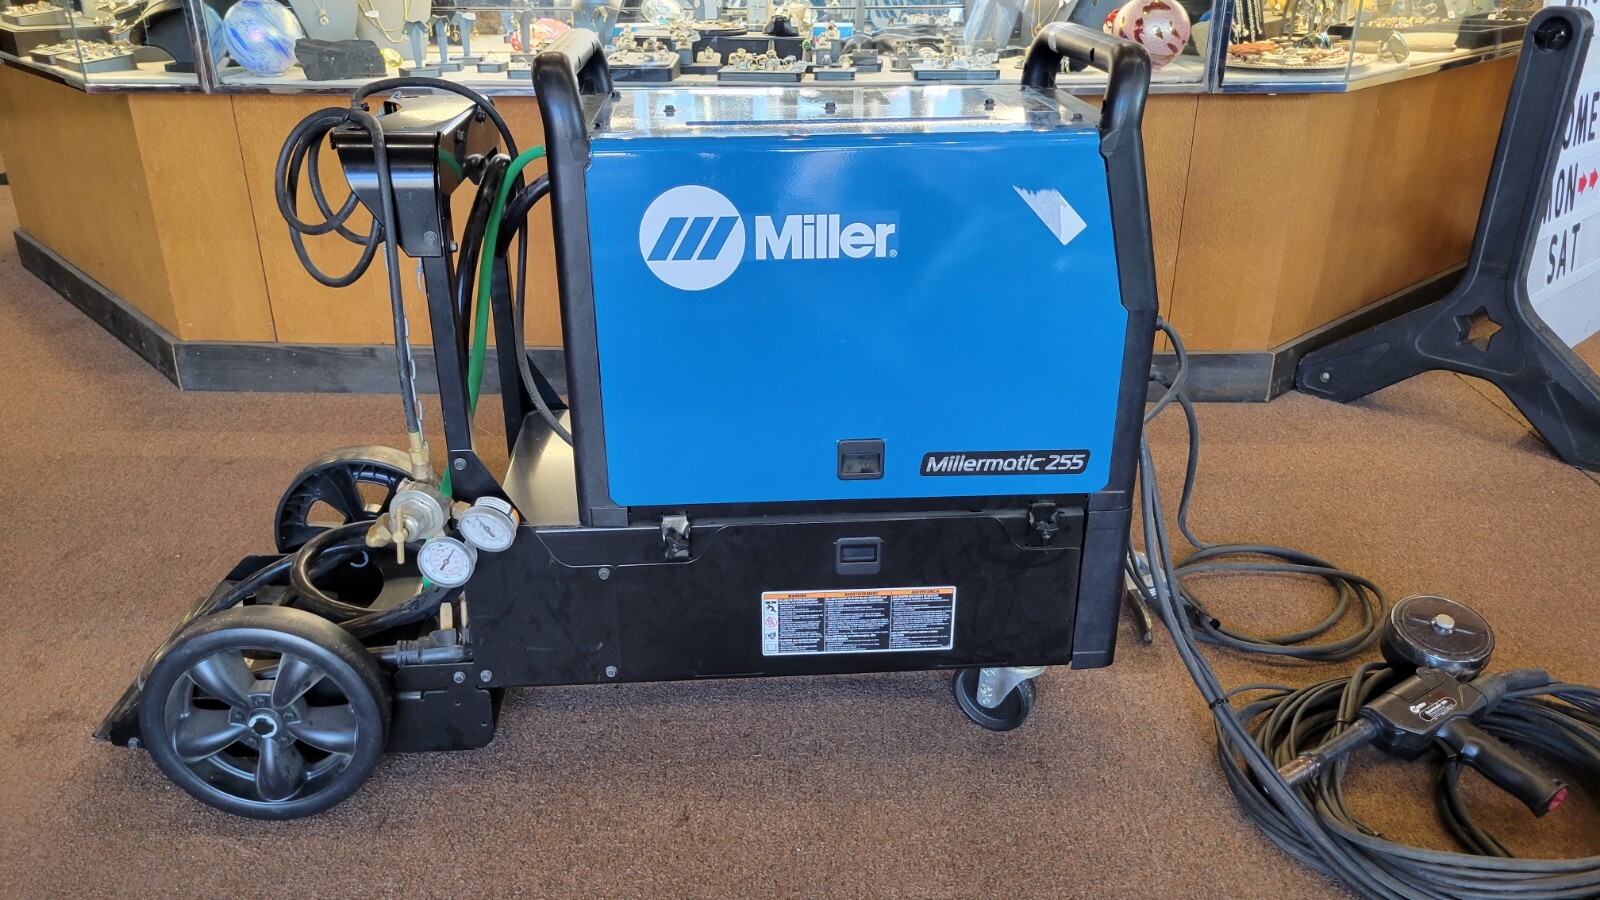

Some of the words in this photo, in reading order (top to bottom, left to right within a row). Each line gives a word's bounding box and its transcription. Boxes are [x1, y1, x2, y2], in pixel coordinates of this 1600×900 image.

[755, 214, 896, 260] Miller
[1546, 222, 1581, 285] SAT
[925, 453, 1043, 473] Millermatic
[1044, 453, 1086, 471] 255
